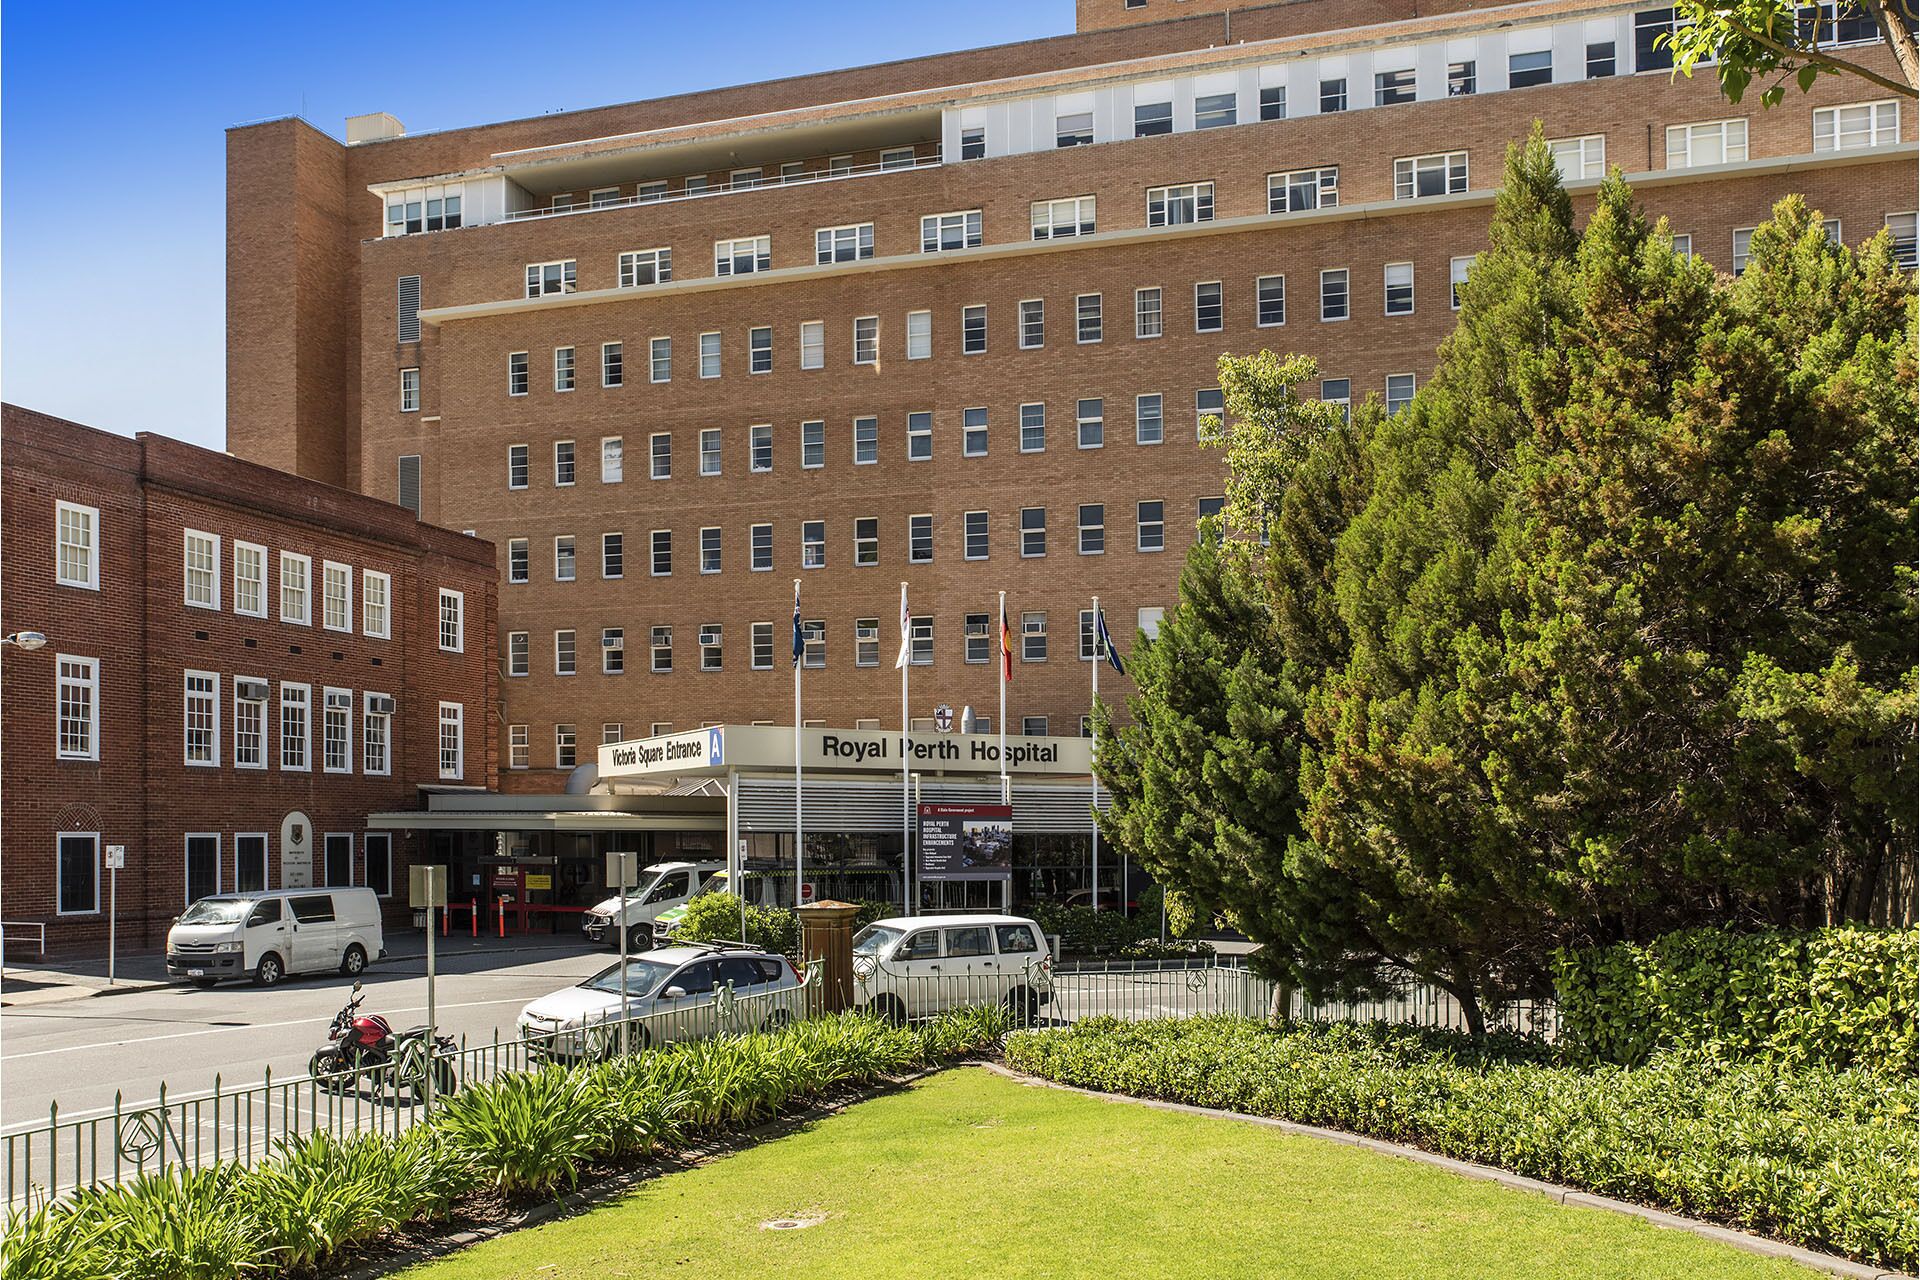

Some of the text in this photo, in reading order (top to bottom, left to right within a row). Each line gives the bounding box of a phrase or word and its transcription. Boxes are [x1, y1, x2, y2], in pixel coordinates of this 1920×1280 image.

[612, 741, 702, 768] Victoria Square Entrance
[711, 733, 720, 758] A
[822, 735, 1058, 766] Royal Perth Hospital
